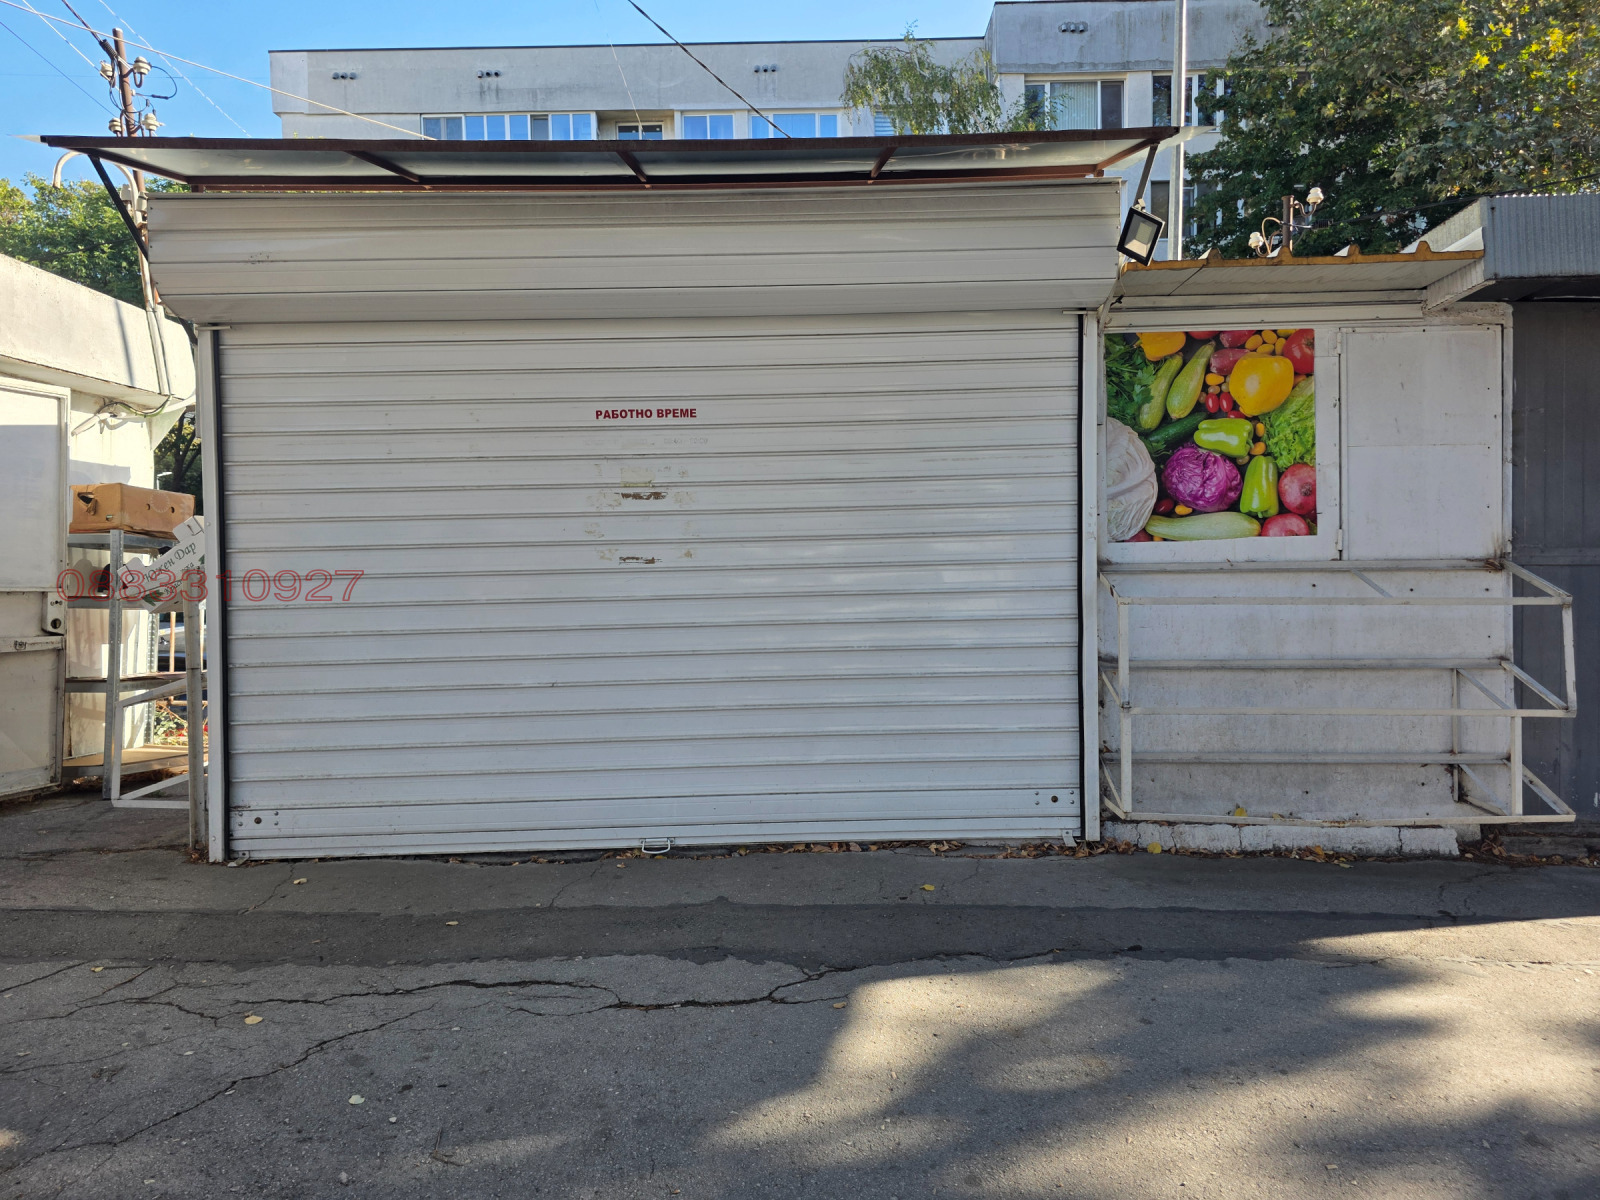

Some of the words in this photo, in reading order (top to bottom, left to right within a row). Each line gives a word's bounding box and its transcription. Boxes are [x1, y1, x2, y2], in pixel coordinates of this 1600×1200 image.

[595, 409, 653, 420] РАБОТНО
[656, 408, 697, 418] ВРЕМЕ
[174, 542, 197, 561] Дар
